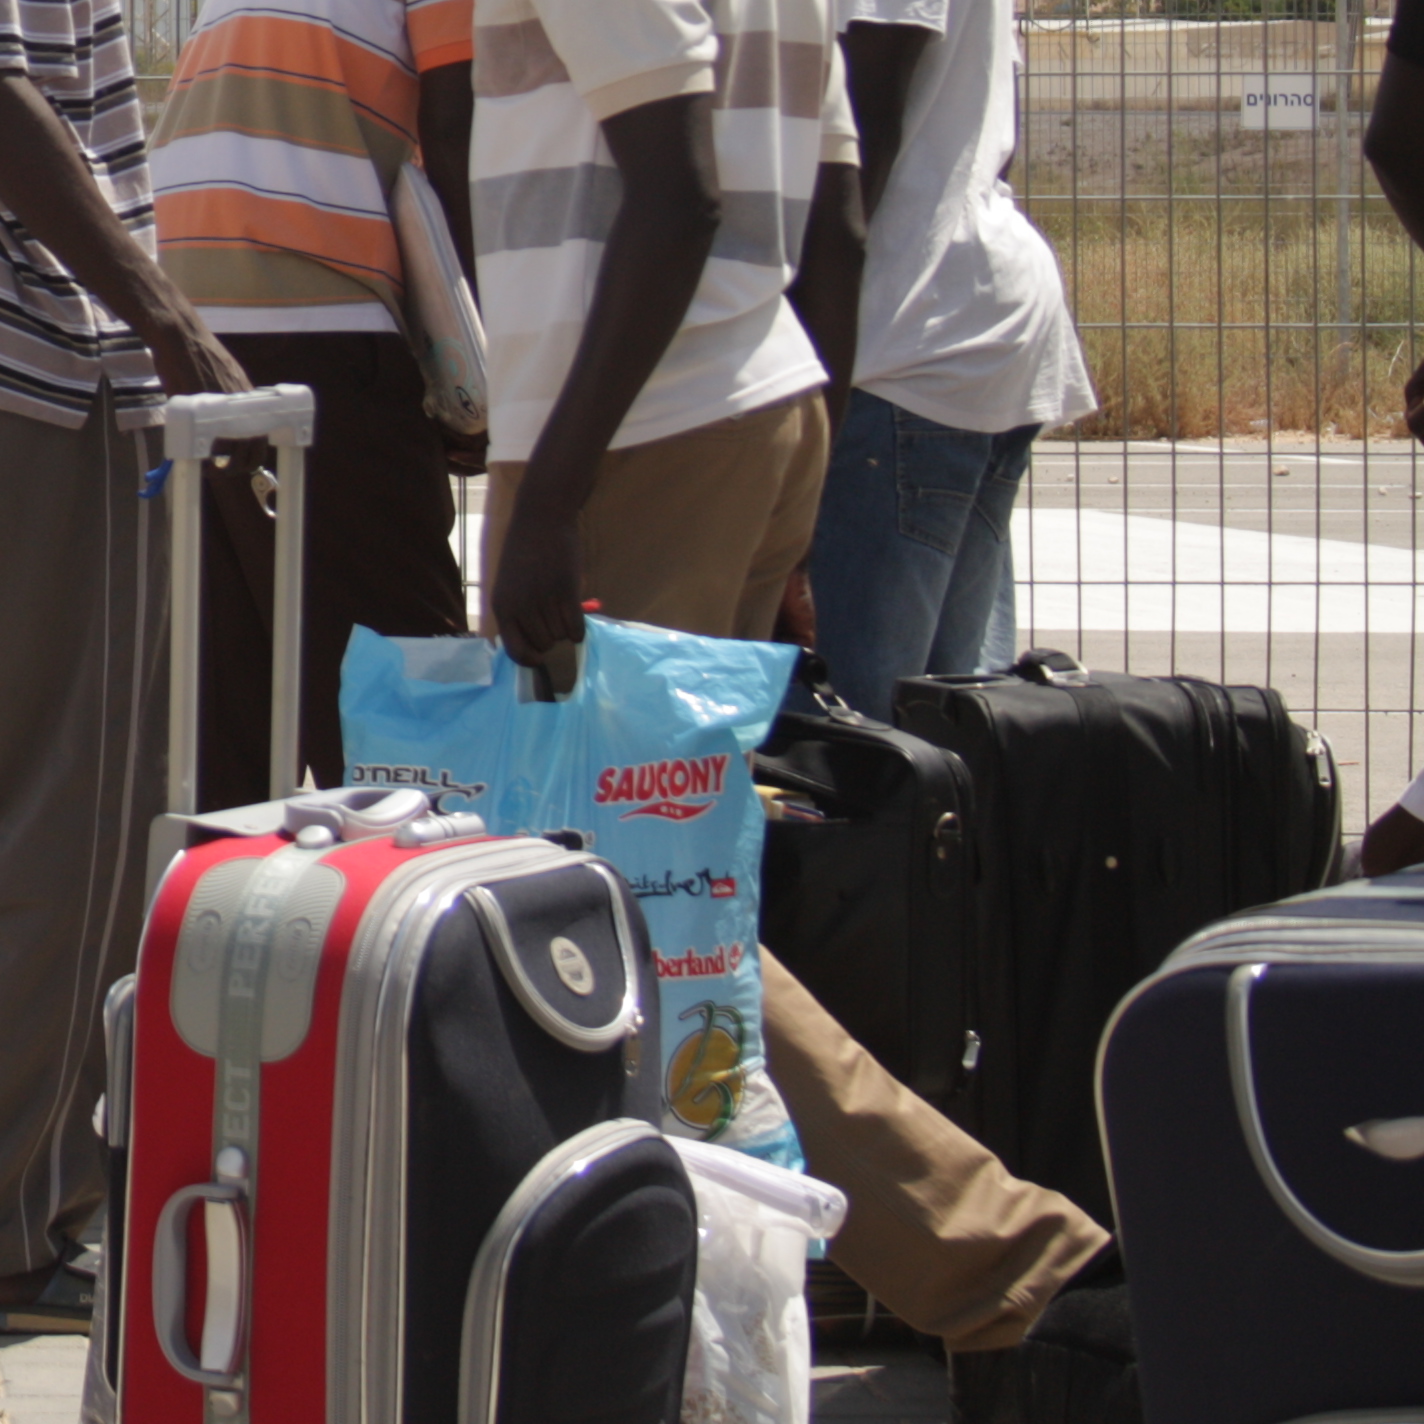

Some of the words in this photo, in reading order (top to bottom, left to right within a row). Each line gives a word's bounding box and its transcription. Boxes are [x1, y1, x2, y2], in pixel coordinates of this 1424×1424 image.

[1246, 93, 1315, 107] סהרונים
[594, 754, 729, 804] SAUCONY
[652, 946, 727, 978] berland
